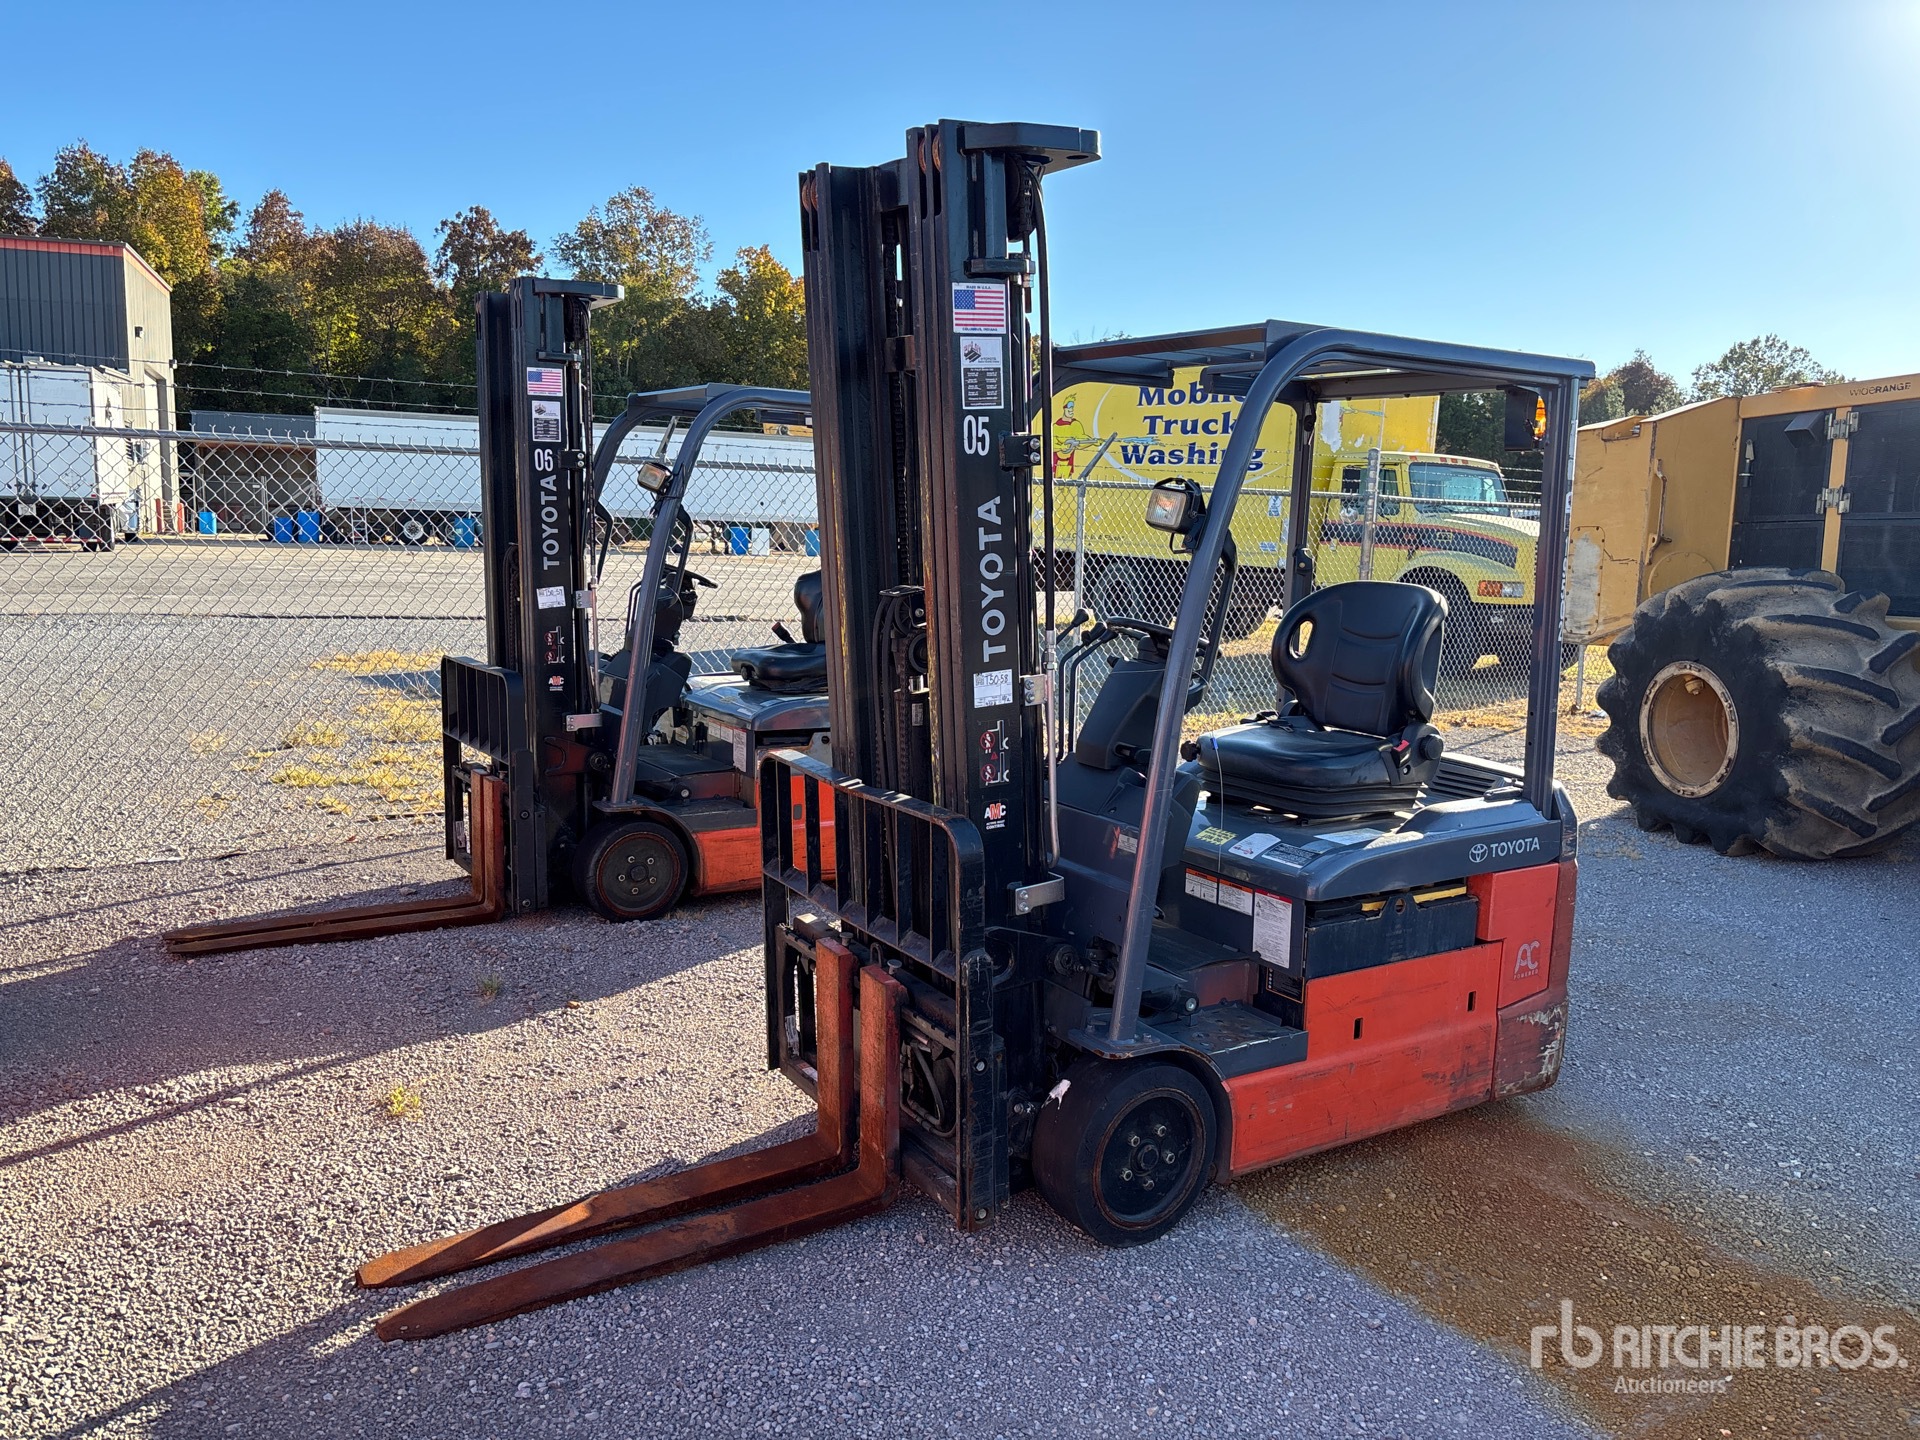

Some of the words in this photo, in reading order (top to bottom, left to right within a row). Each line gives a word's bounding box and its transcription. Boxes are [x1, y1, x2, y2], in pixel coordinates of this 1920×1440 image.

[963, 415, 990, 456] 05
[534, 448, 554, 472] 06
[1119, 442, 1266, 472] Washig
[539, 474, 560, 571] TOYOTA
[977, 495, 1007, 663] TOYOTA
[984, 802, 1007, 820] AMC
[1490, 836, 1541, 858] TOYOTA
[1514, 940, 1541, 973] AC
[1513, 969, 1539, 980] POWERED
